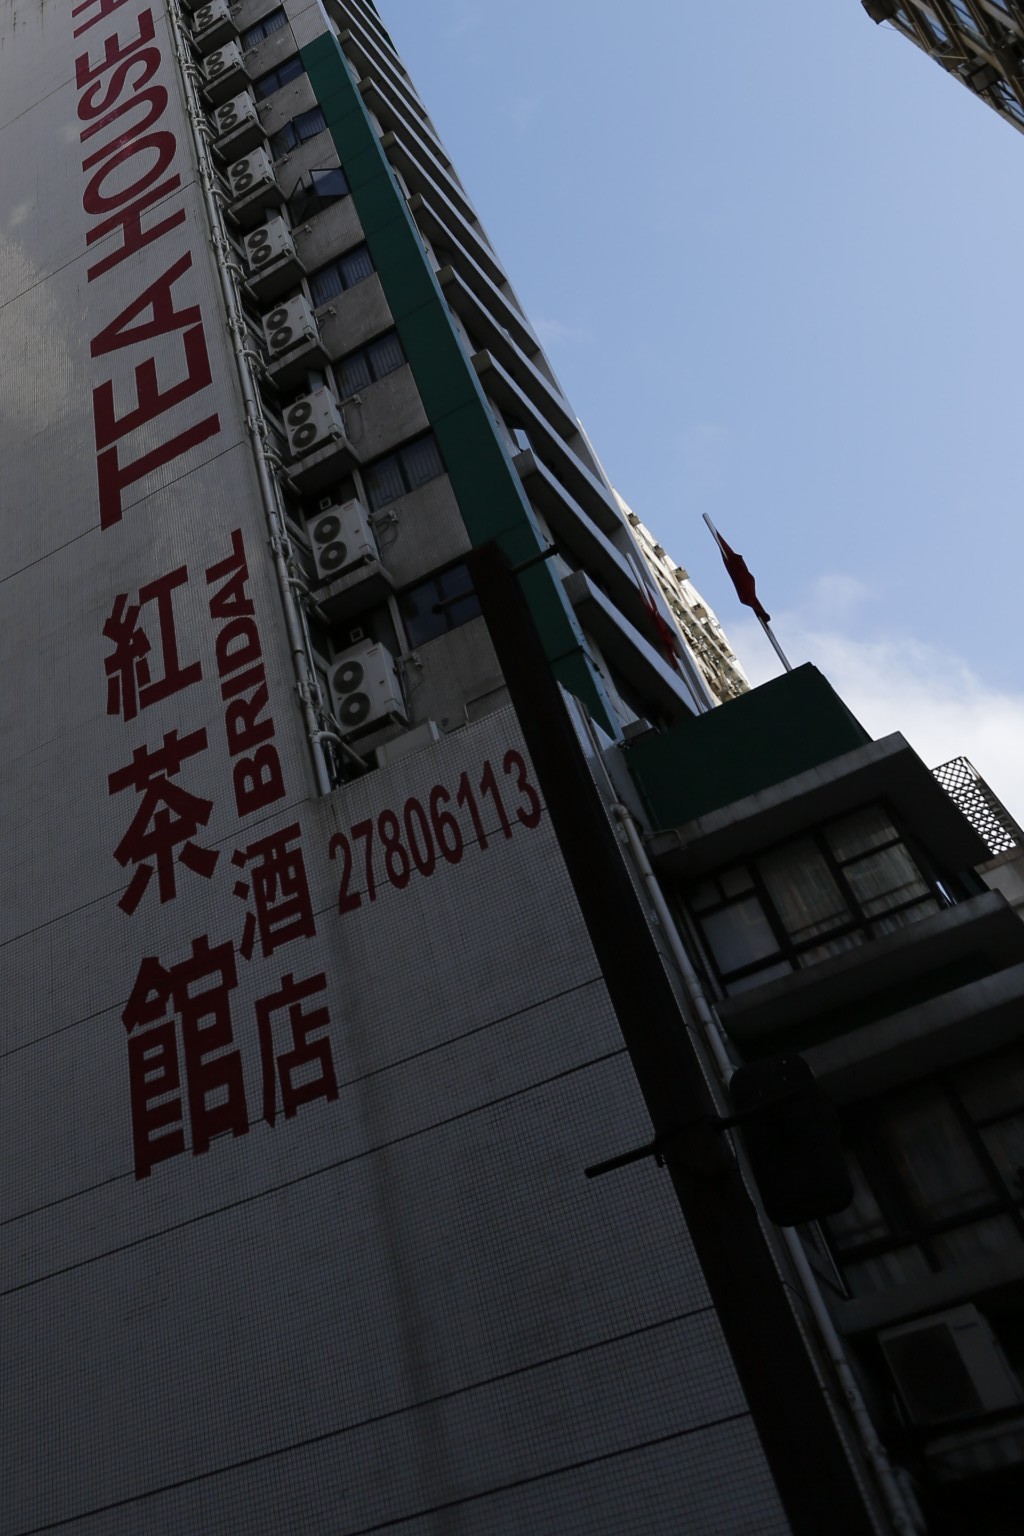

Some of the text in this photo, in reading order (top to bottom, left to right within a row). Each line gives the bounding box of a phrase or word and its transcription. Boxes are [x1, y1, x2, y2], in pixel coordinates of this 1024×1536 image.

[76, 9, 186, 282] HOUSE
[91, 252, 222, 530] TEA
[205, 530, 286, 817] BRIDAL
[103, 566, 250, 1180] 紅茶館
[329, 750, 541, 915] 27806113
[229, 822, 338, 1128] 酒店
